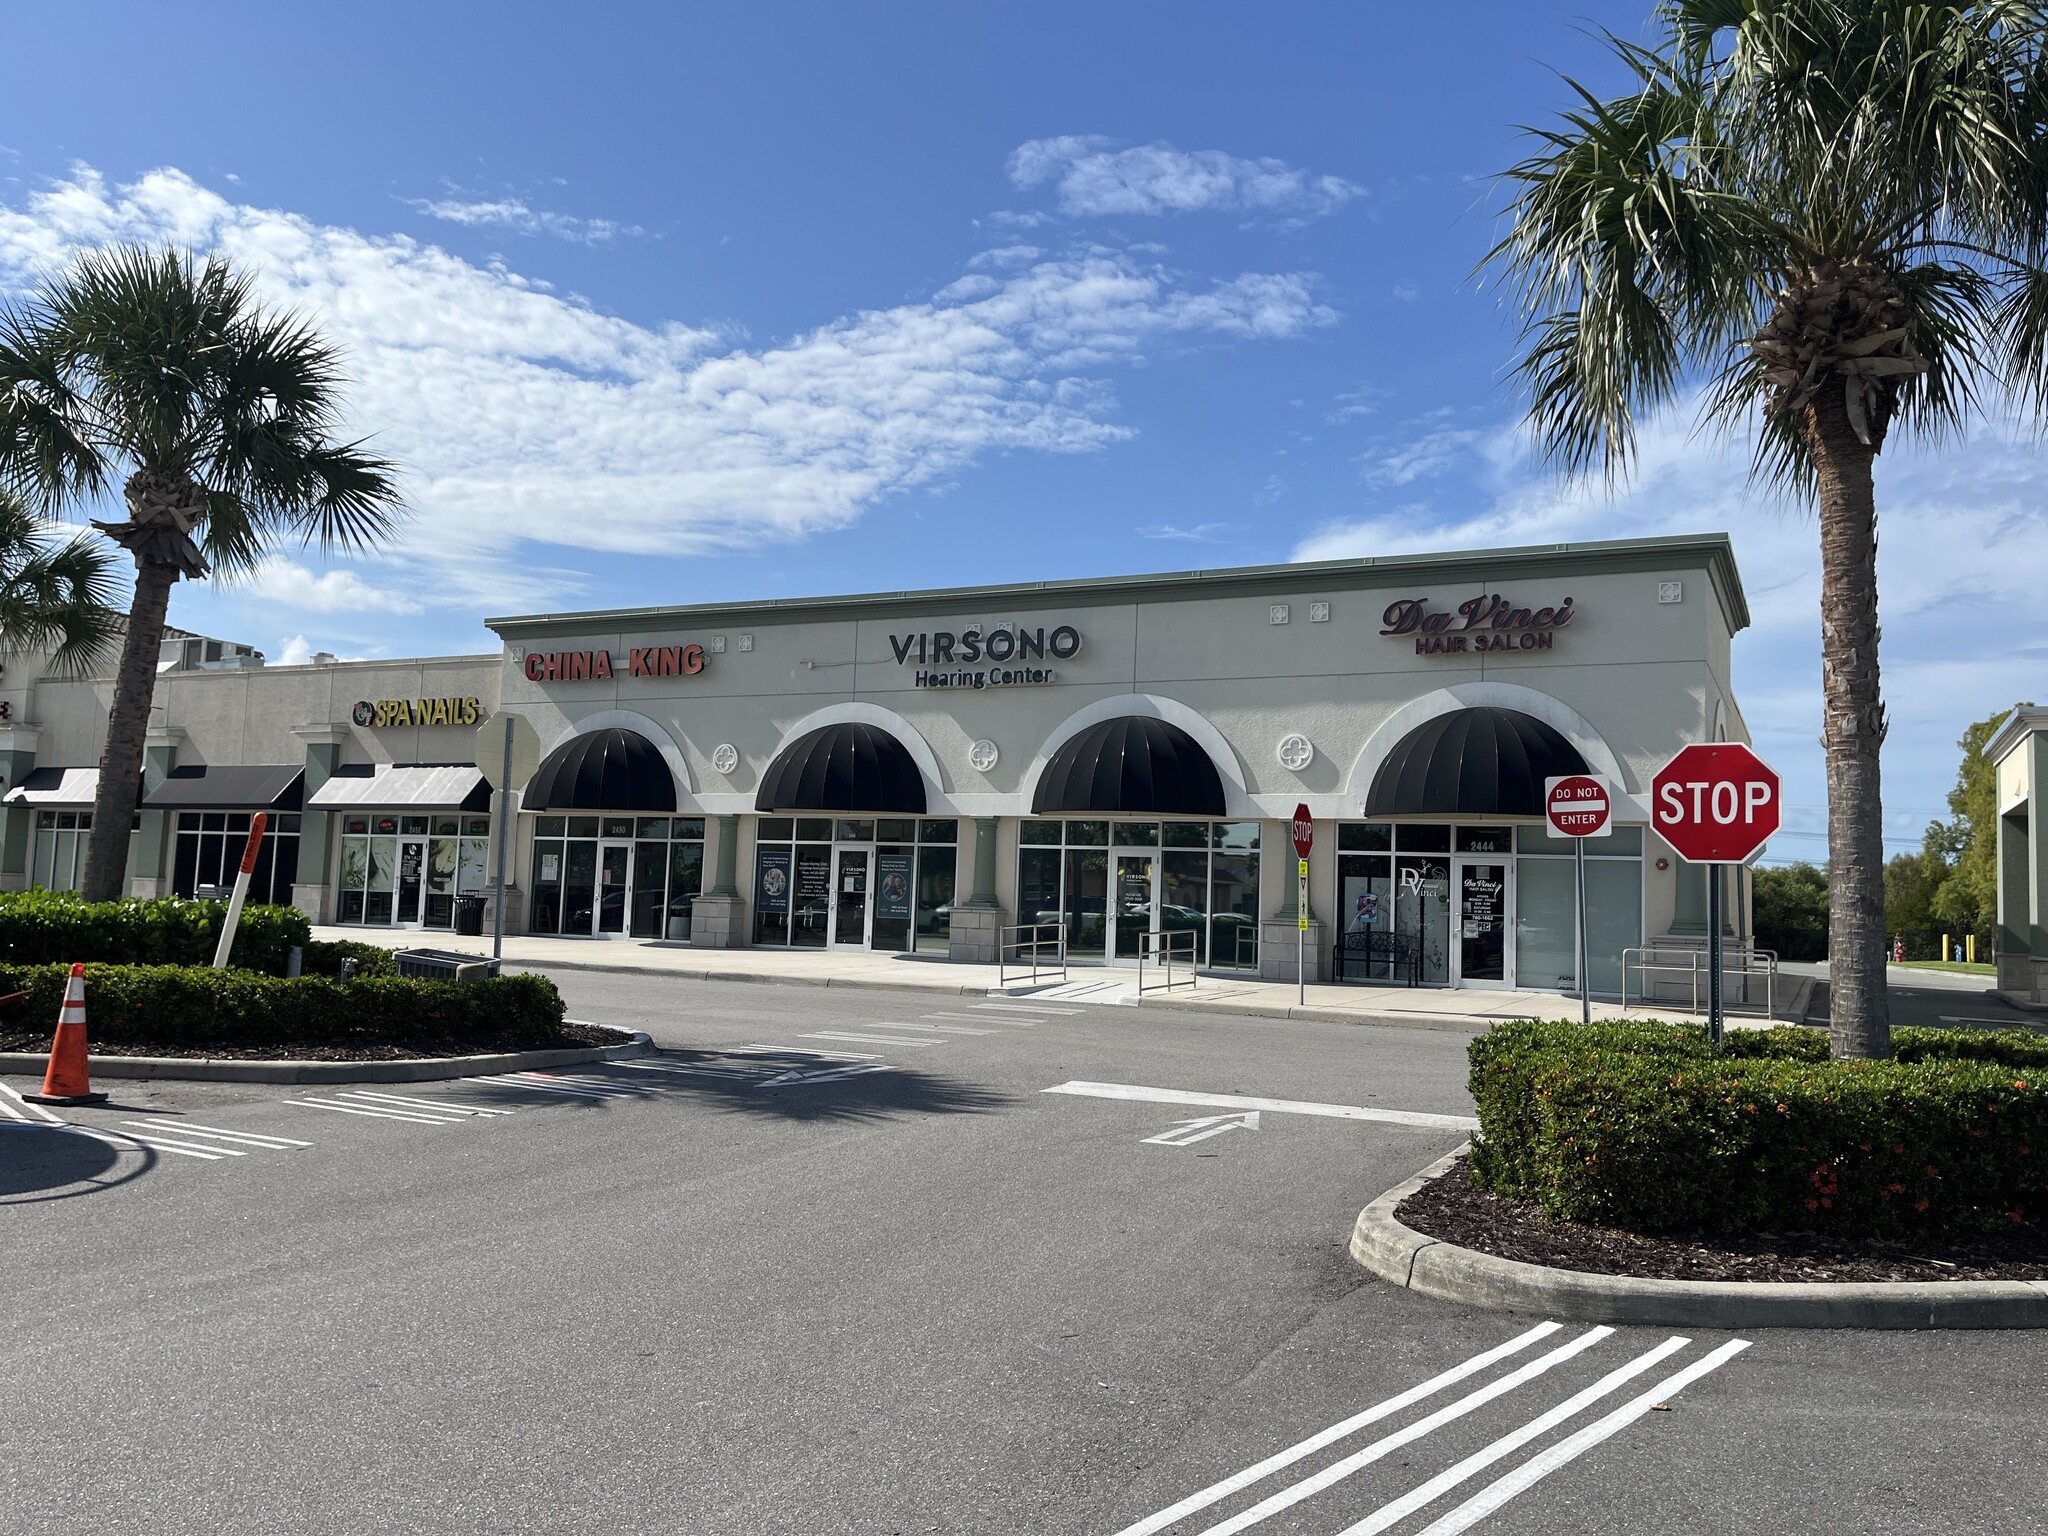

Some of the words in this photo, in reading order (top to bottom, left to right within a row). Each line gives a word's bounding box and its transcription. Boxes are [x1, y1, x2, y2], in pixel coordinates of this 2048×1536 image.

[1379, 598, 1454, 636] Da
[1458, 594, 1575, 632] Vinci
[889, 625, 1081, 666] VIRSONO
[1415, 636, 1468, 655] HAIR
[1474, 632, 1553, 652] SALON
[524, 650, 613, 682] CHINA
[628, 644, 705, 677] KING
[915, 669, 985, 690] Hearing
[989, 667, 1053, 685] Center
[375, 699, 413, 728] SPA
[415, 697, 480, 726] NAILS
[1556, 788, 1571, 799] DO
[1577, 787, 1598, 798] NOT
[1659, 780, 1772, 825] STOP
[612, 825, 626, 834] 2450
[1561, 814, 1597, 825] ENTER
[1294, 821, 1312, 842] STOP
[1470, 841, 1494, 852] 2444
